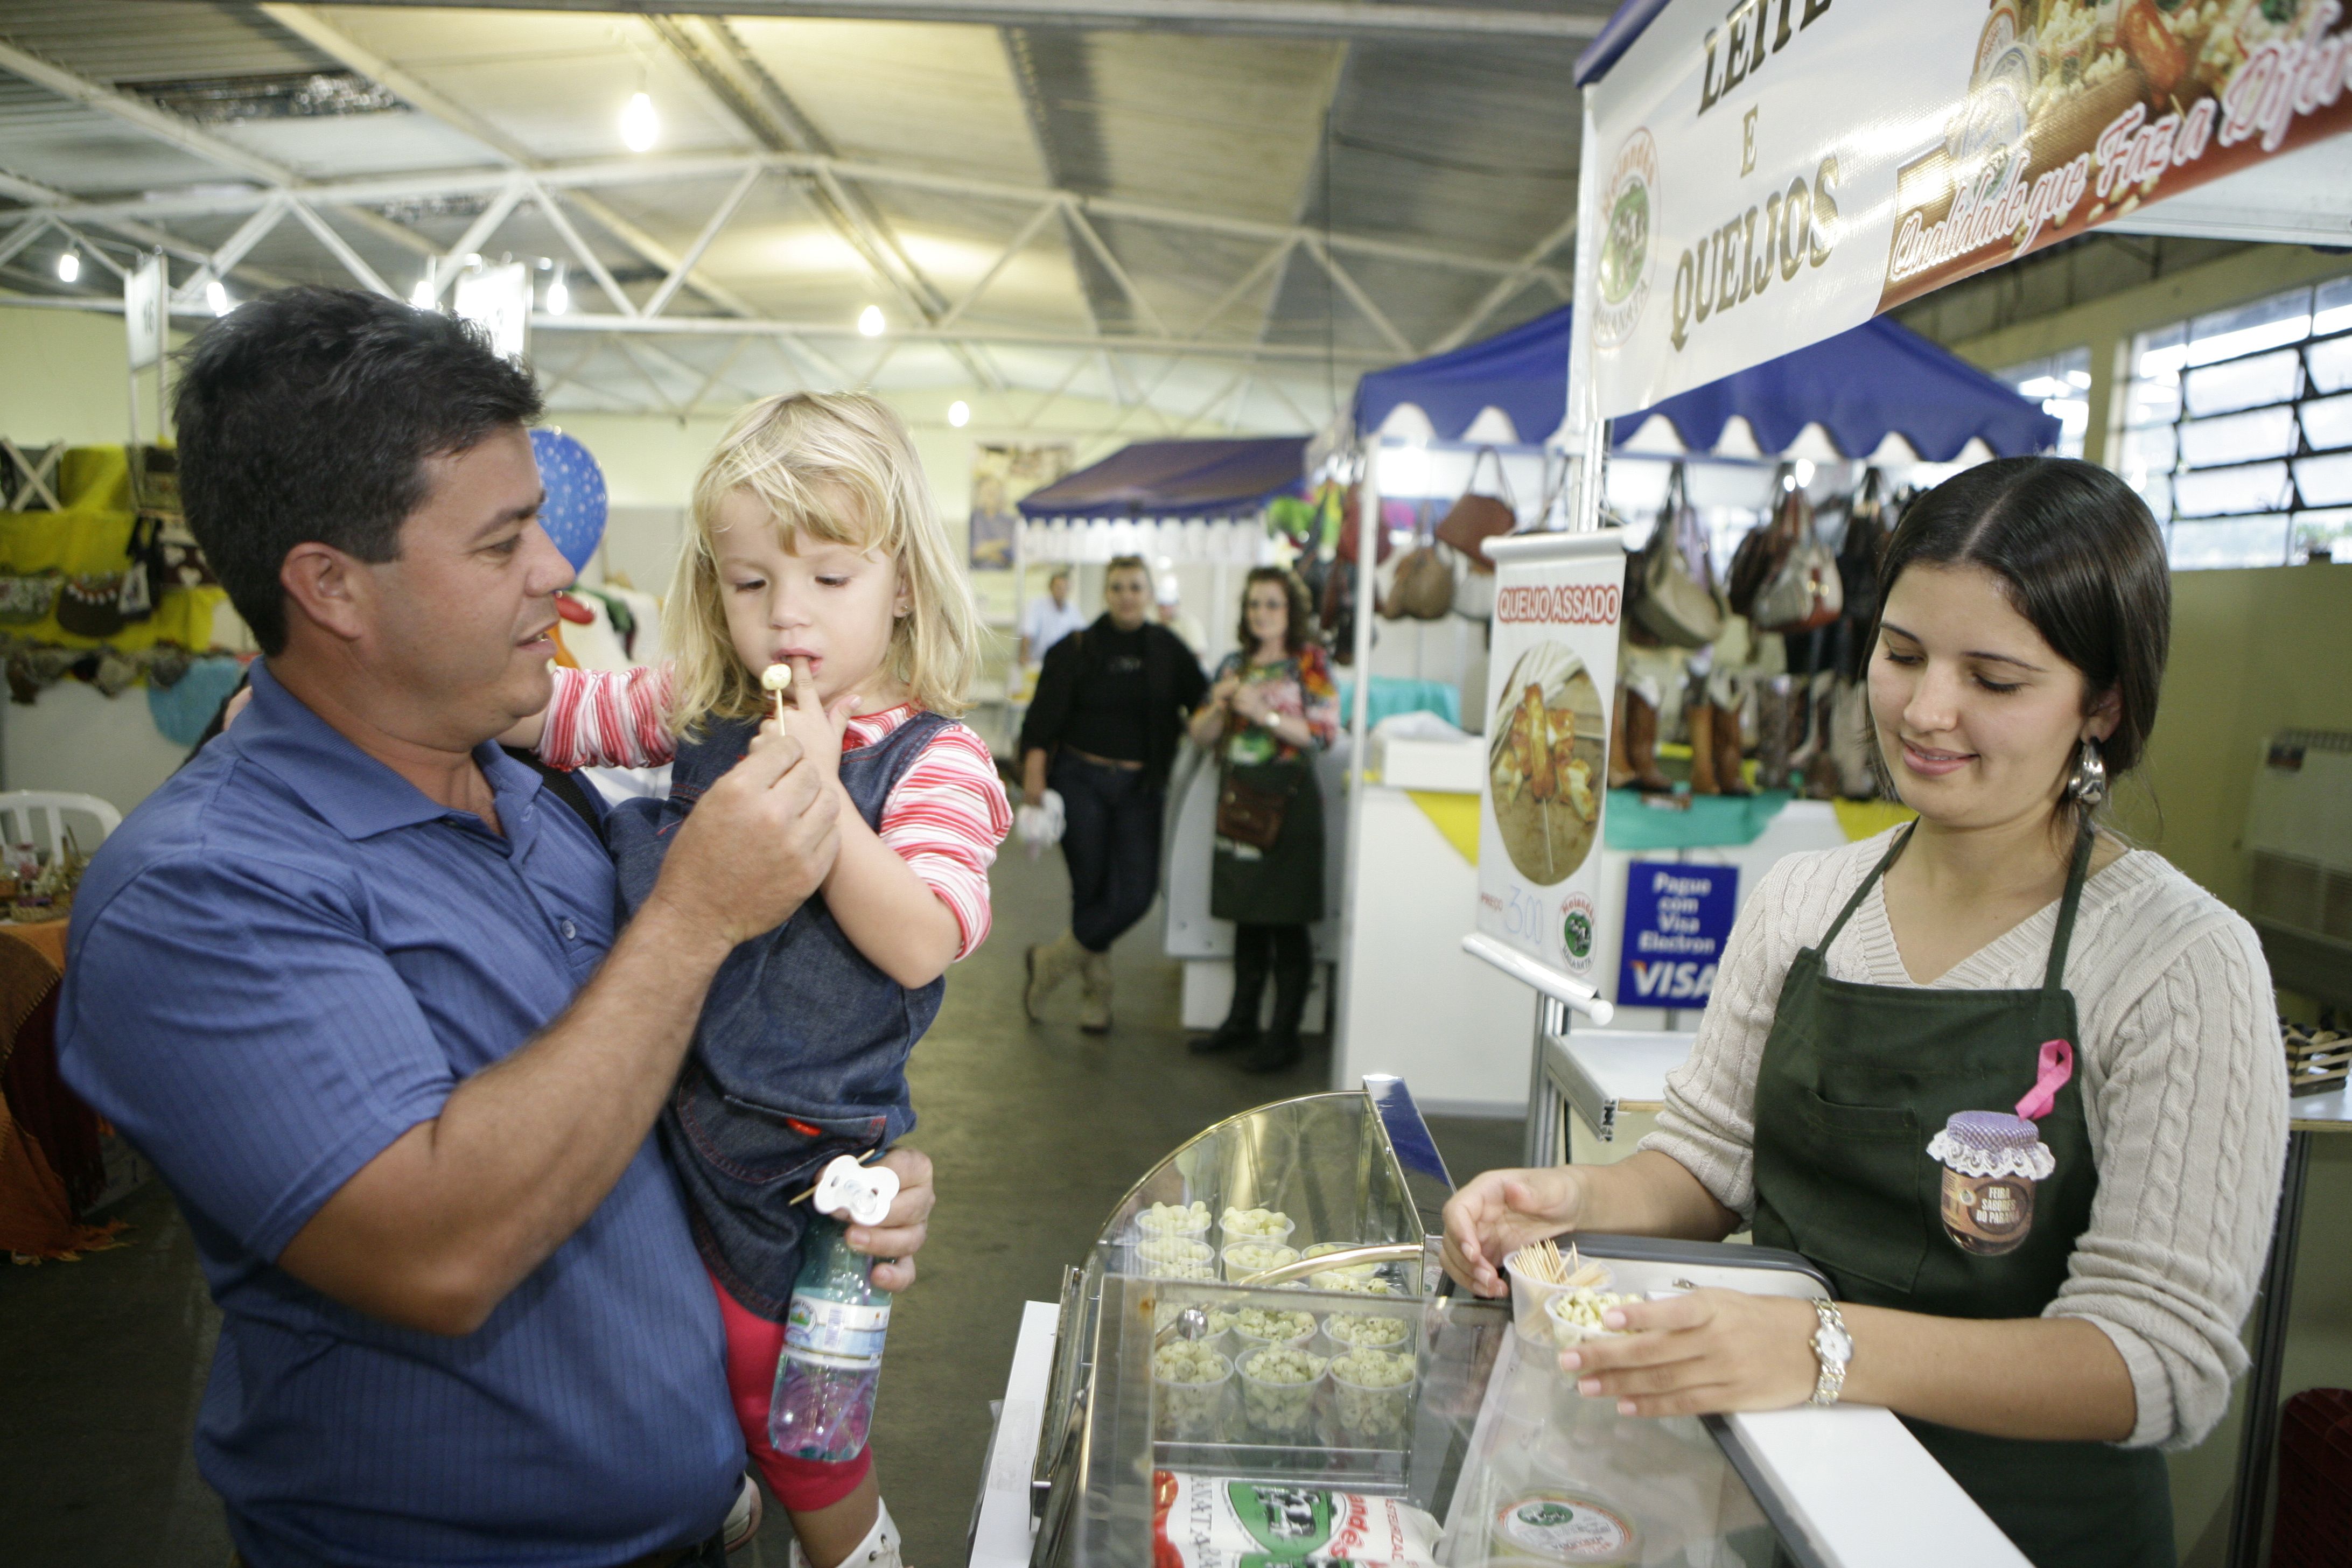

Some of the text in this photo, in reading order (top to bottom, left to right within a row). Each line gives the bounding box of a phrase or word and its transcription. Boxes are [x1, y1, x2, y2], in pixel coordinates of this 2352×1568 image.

[1740, 104, 1759, 178] E
[1891, 148, 2029, 281] Qualidade
[2025, 153, 2089, 260] que
[2097, 101, 2179, 198] Faz
[2173, 97, 2216, 166] a
[1671, 153, 1840, 352] QUEIJOS
[1498, 583, 1621, 625] QUEIJO ASSADO
[1653, 871, 1712, 897] Pague
[1657, 895, 1699, 914] com
[1658, 912, 1700, 934] Visa
[1637, 929, 1716, 955] Electron
[1630, 961, 1718, 998] VISA
[1982, 1198, 2017, 1212] SABORES
[1989, 1186, 2010, 1199] FEIRA
[1976, 1209, 1988, 1223] DO
[1330, 1493, 1370, 1559] andês
